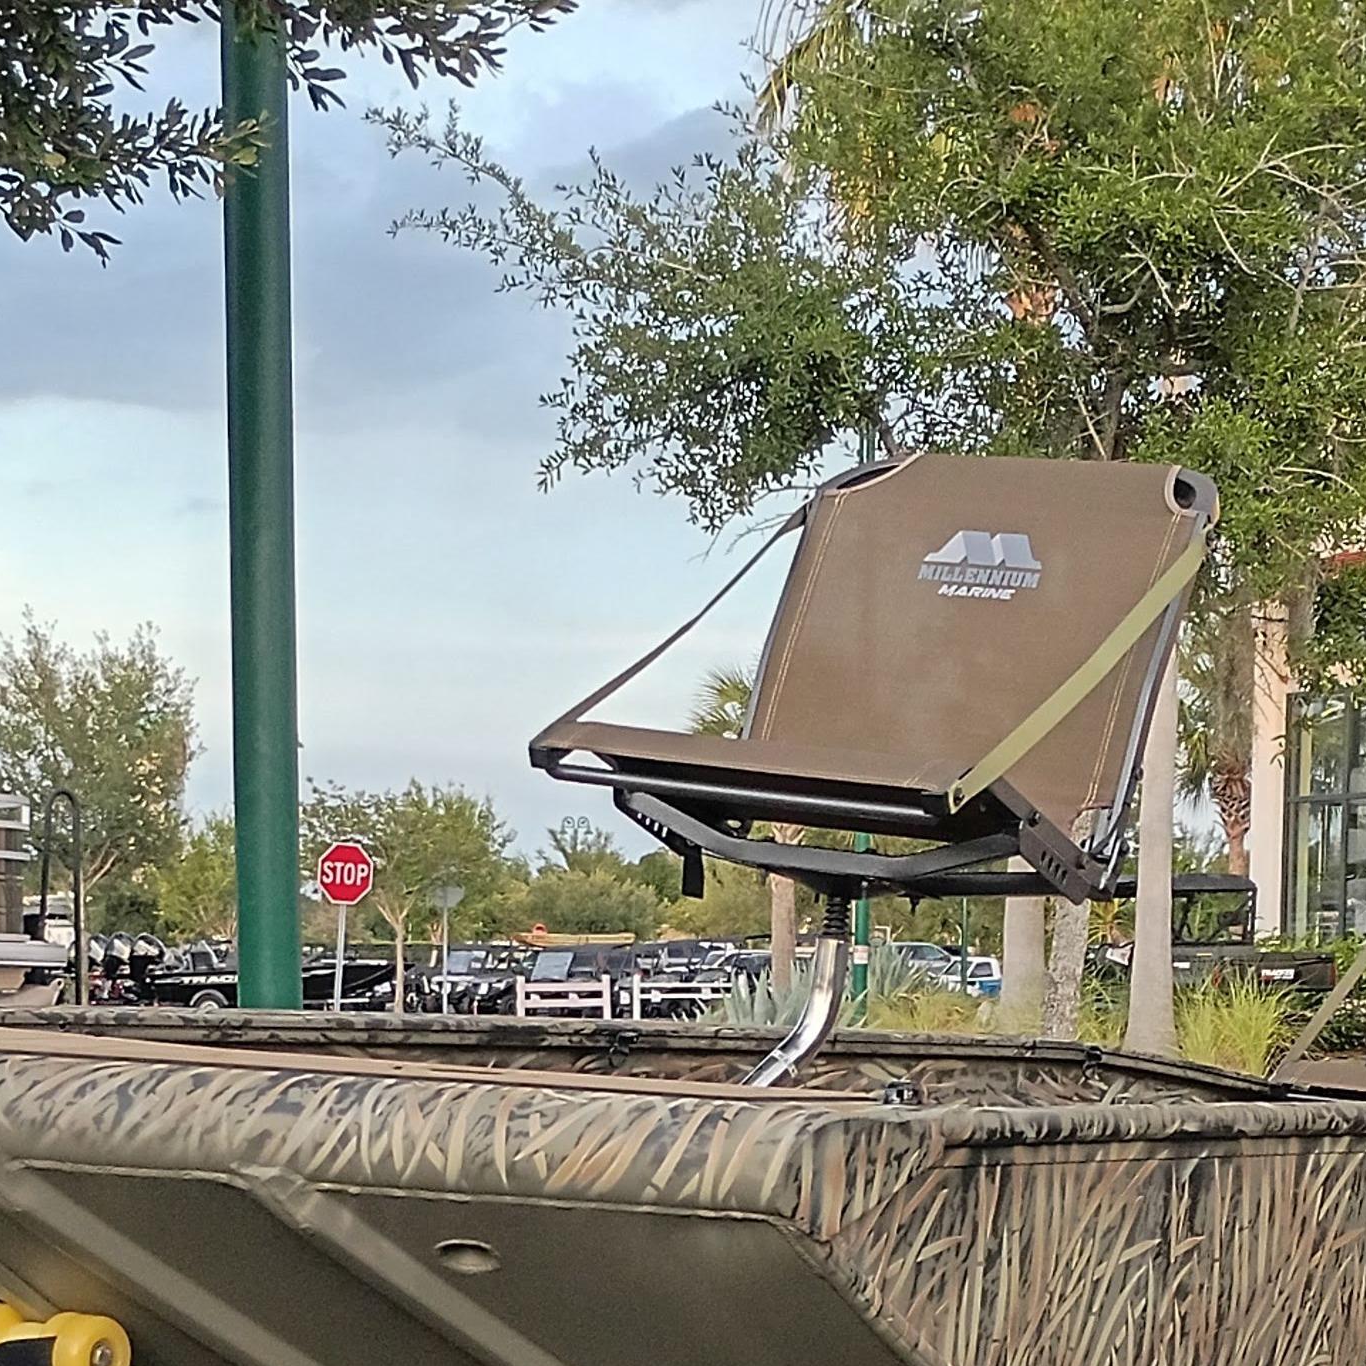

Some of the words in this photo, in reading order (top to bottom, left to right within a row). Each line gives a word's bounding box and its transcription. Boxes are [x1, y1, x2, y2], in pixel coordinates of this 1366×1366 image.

[917, 564, 1041, 588] MILLENNIUM
[937, 584, 1016, 600] MARINE
[321, 860, 369, 886] STOP
[178, 974, 239, 986] TRAC
